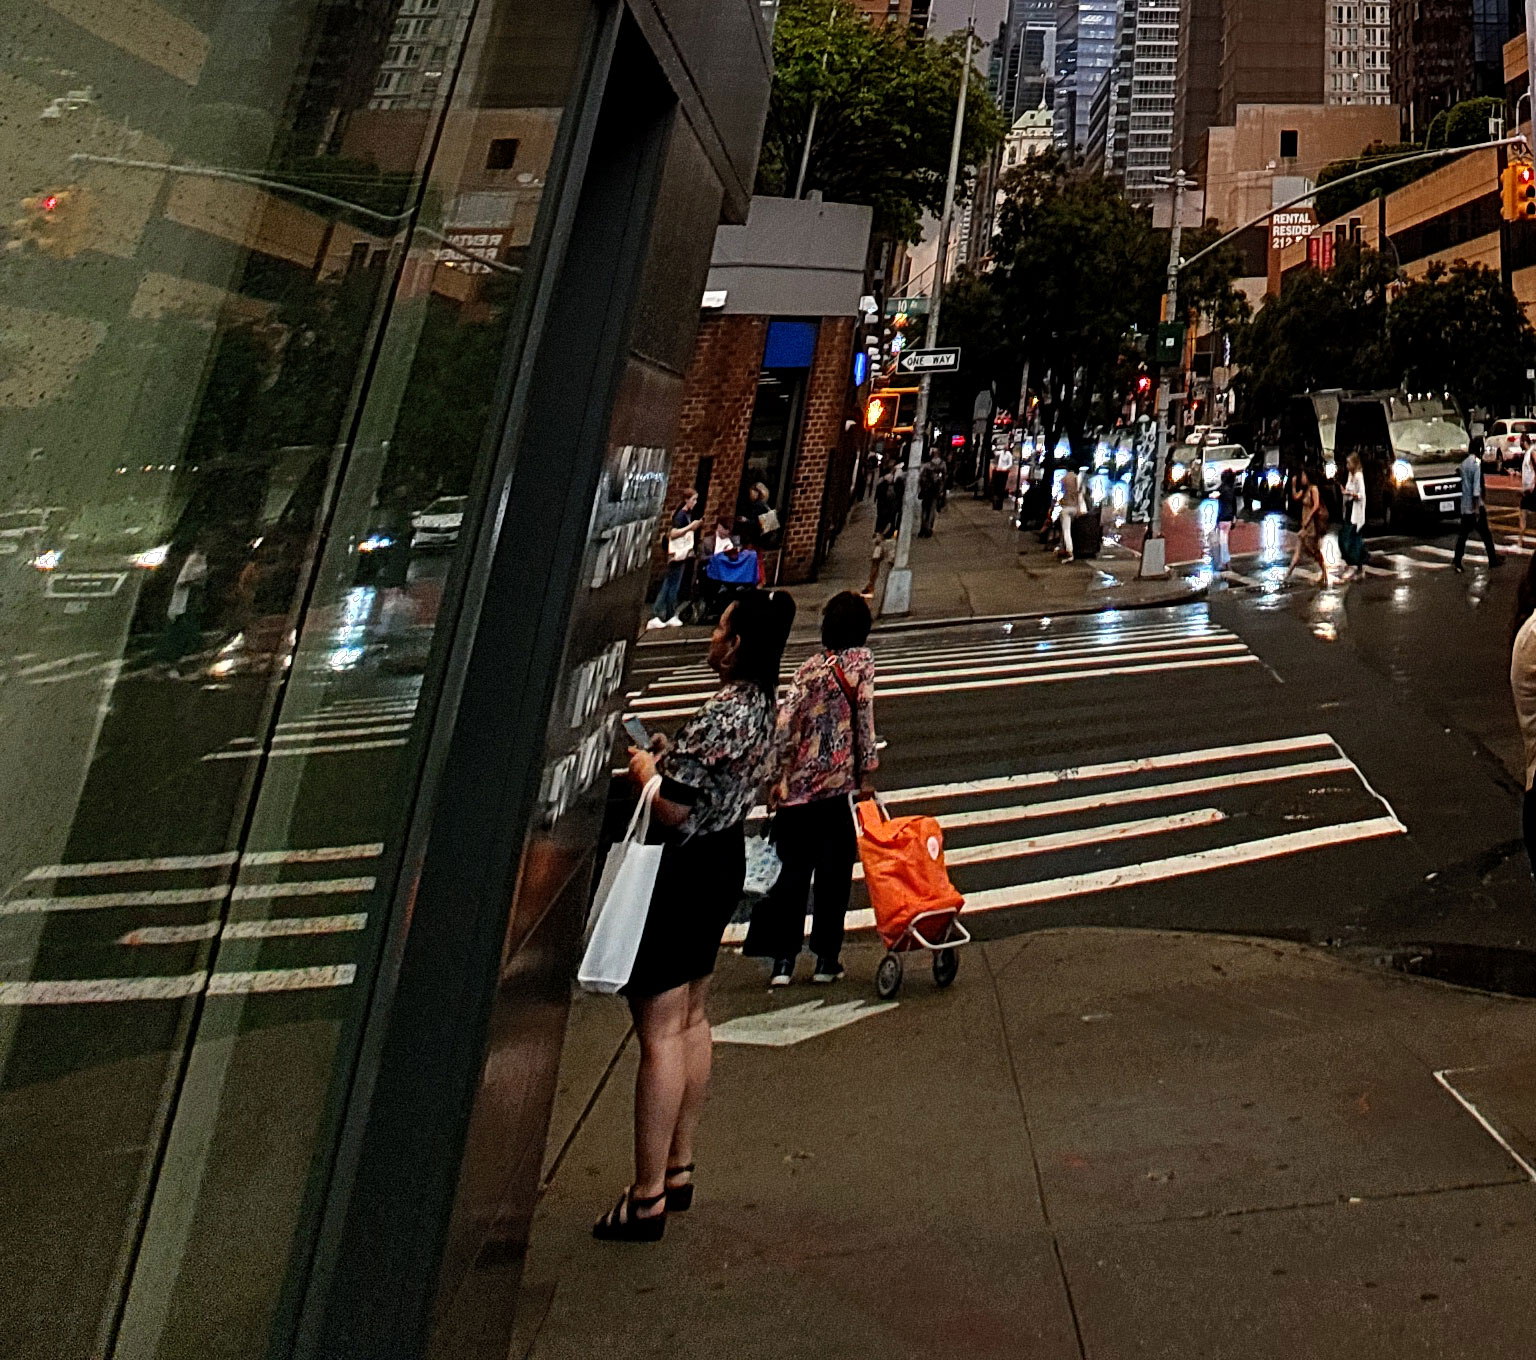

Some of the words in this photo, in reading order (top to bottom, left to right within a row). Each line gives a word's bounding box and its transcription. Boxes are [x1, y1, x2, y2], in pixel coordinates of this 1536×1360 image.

[1272, 213, 1311, 225] RENTAL
[906, 357, 925, 366] ONE
[932, 355, 952, 364] WAY
